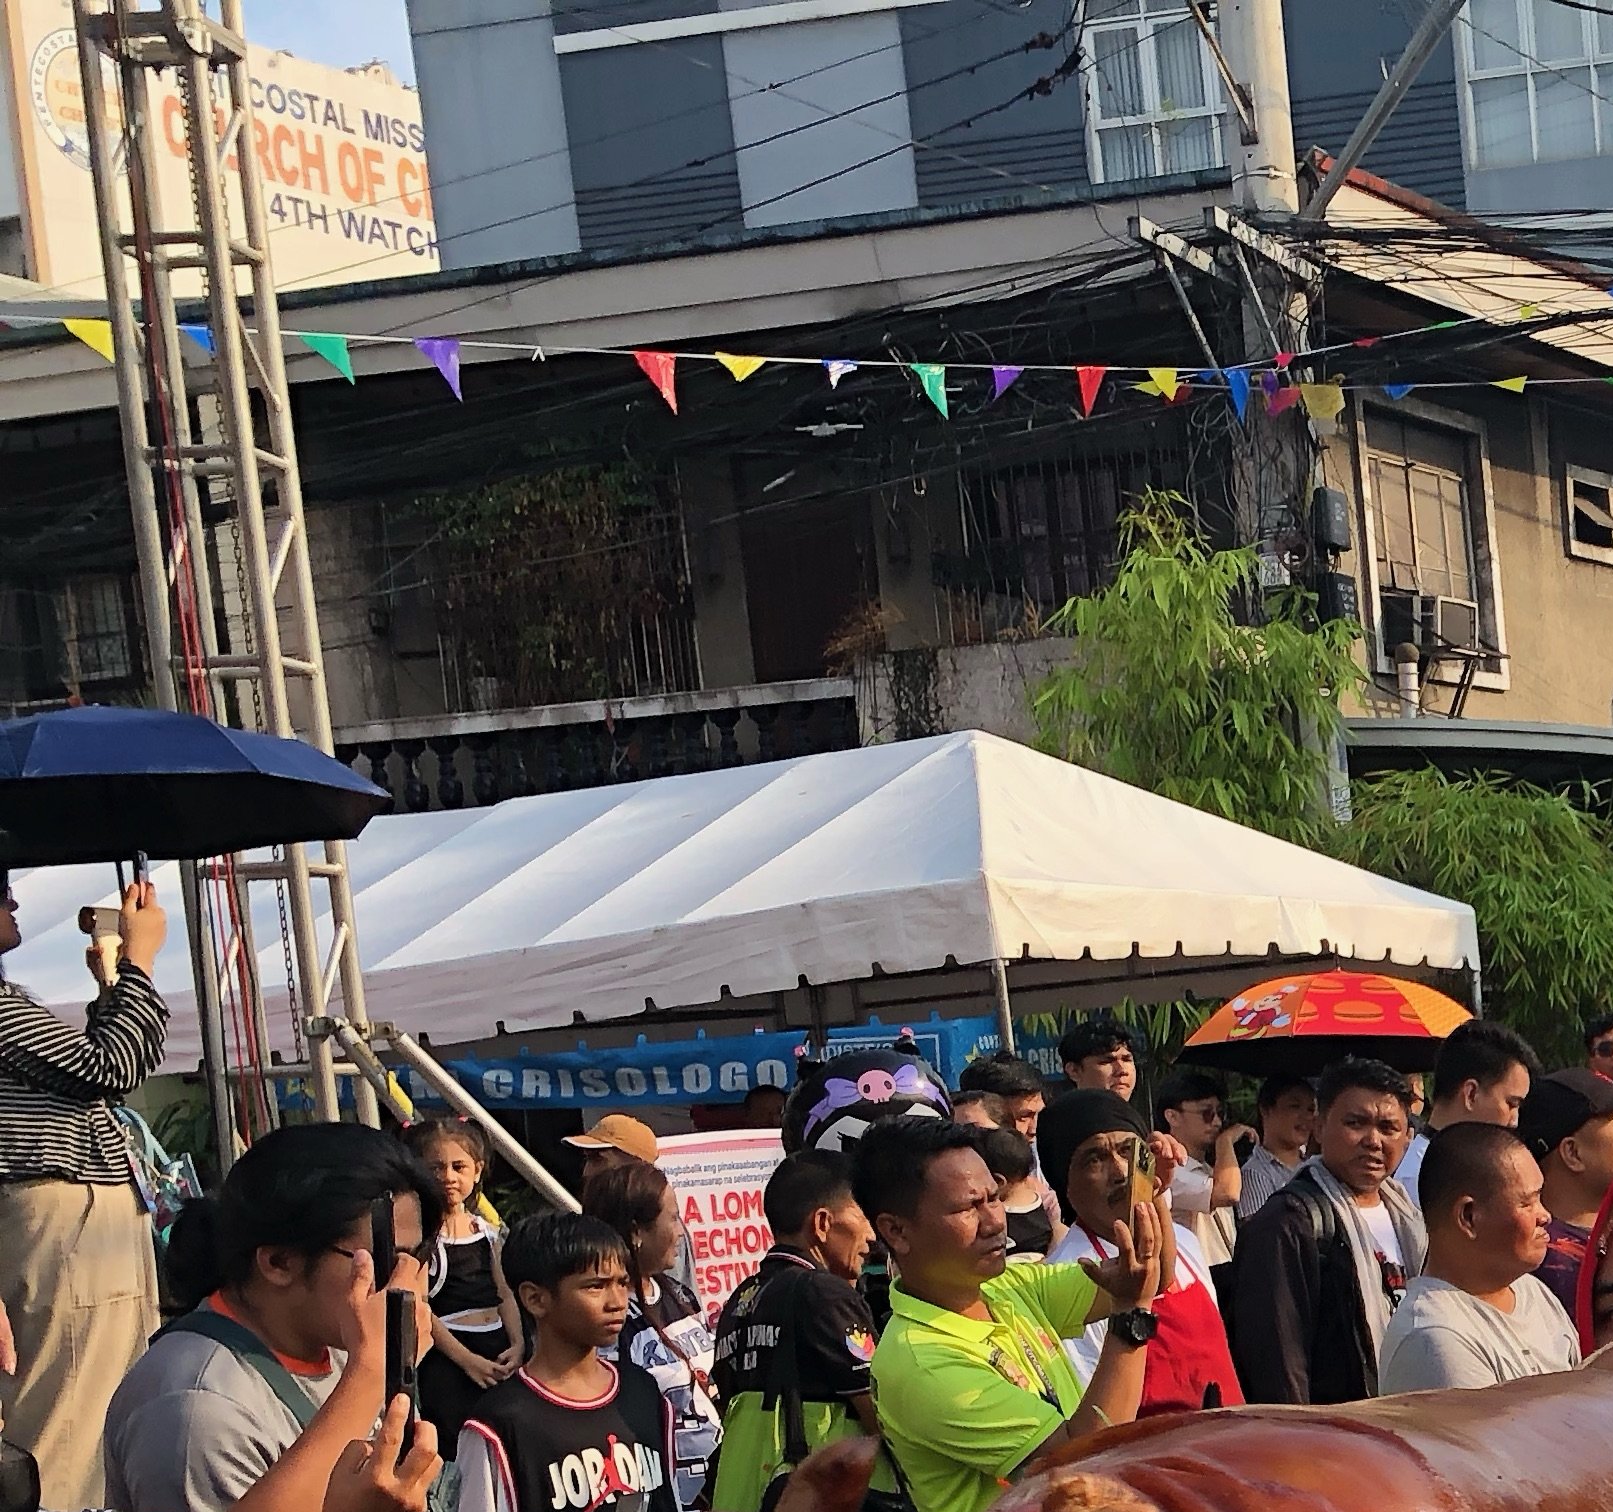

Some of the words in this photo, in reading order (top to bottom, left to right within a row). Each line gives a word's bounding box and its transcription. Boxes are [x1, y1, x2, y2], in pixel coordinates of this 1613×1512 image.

[162, 94, 330, 195] CRCH
[337, 141, 386, 206] OF
[269, 192, 330, 235] 4TH
[483, 1059, 788, 1099] CRISOLOGO
[710, 1190, 763, 1220] LOM
[694, 1224, 774, 1258] ECHON
[548, 1442, 663, 1512] JORDAN
